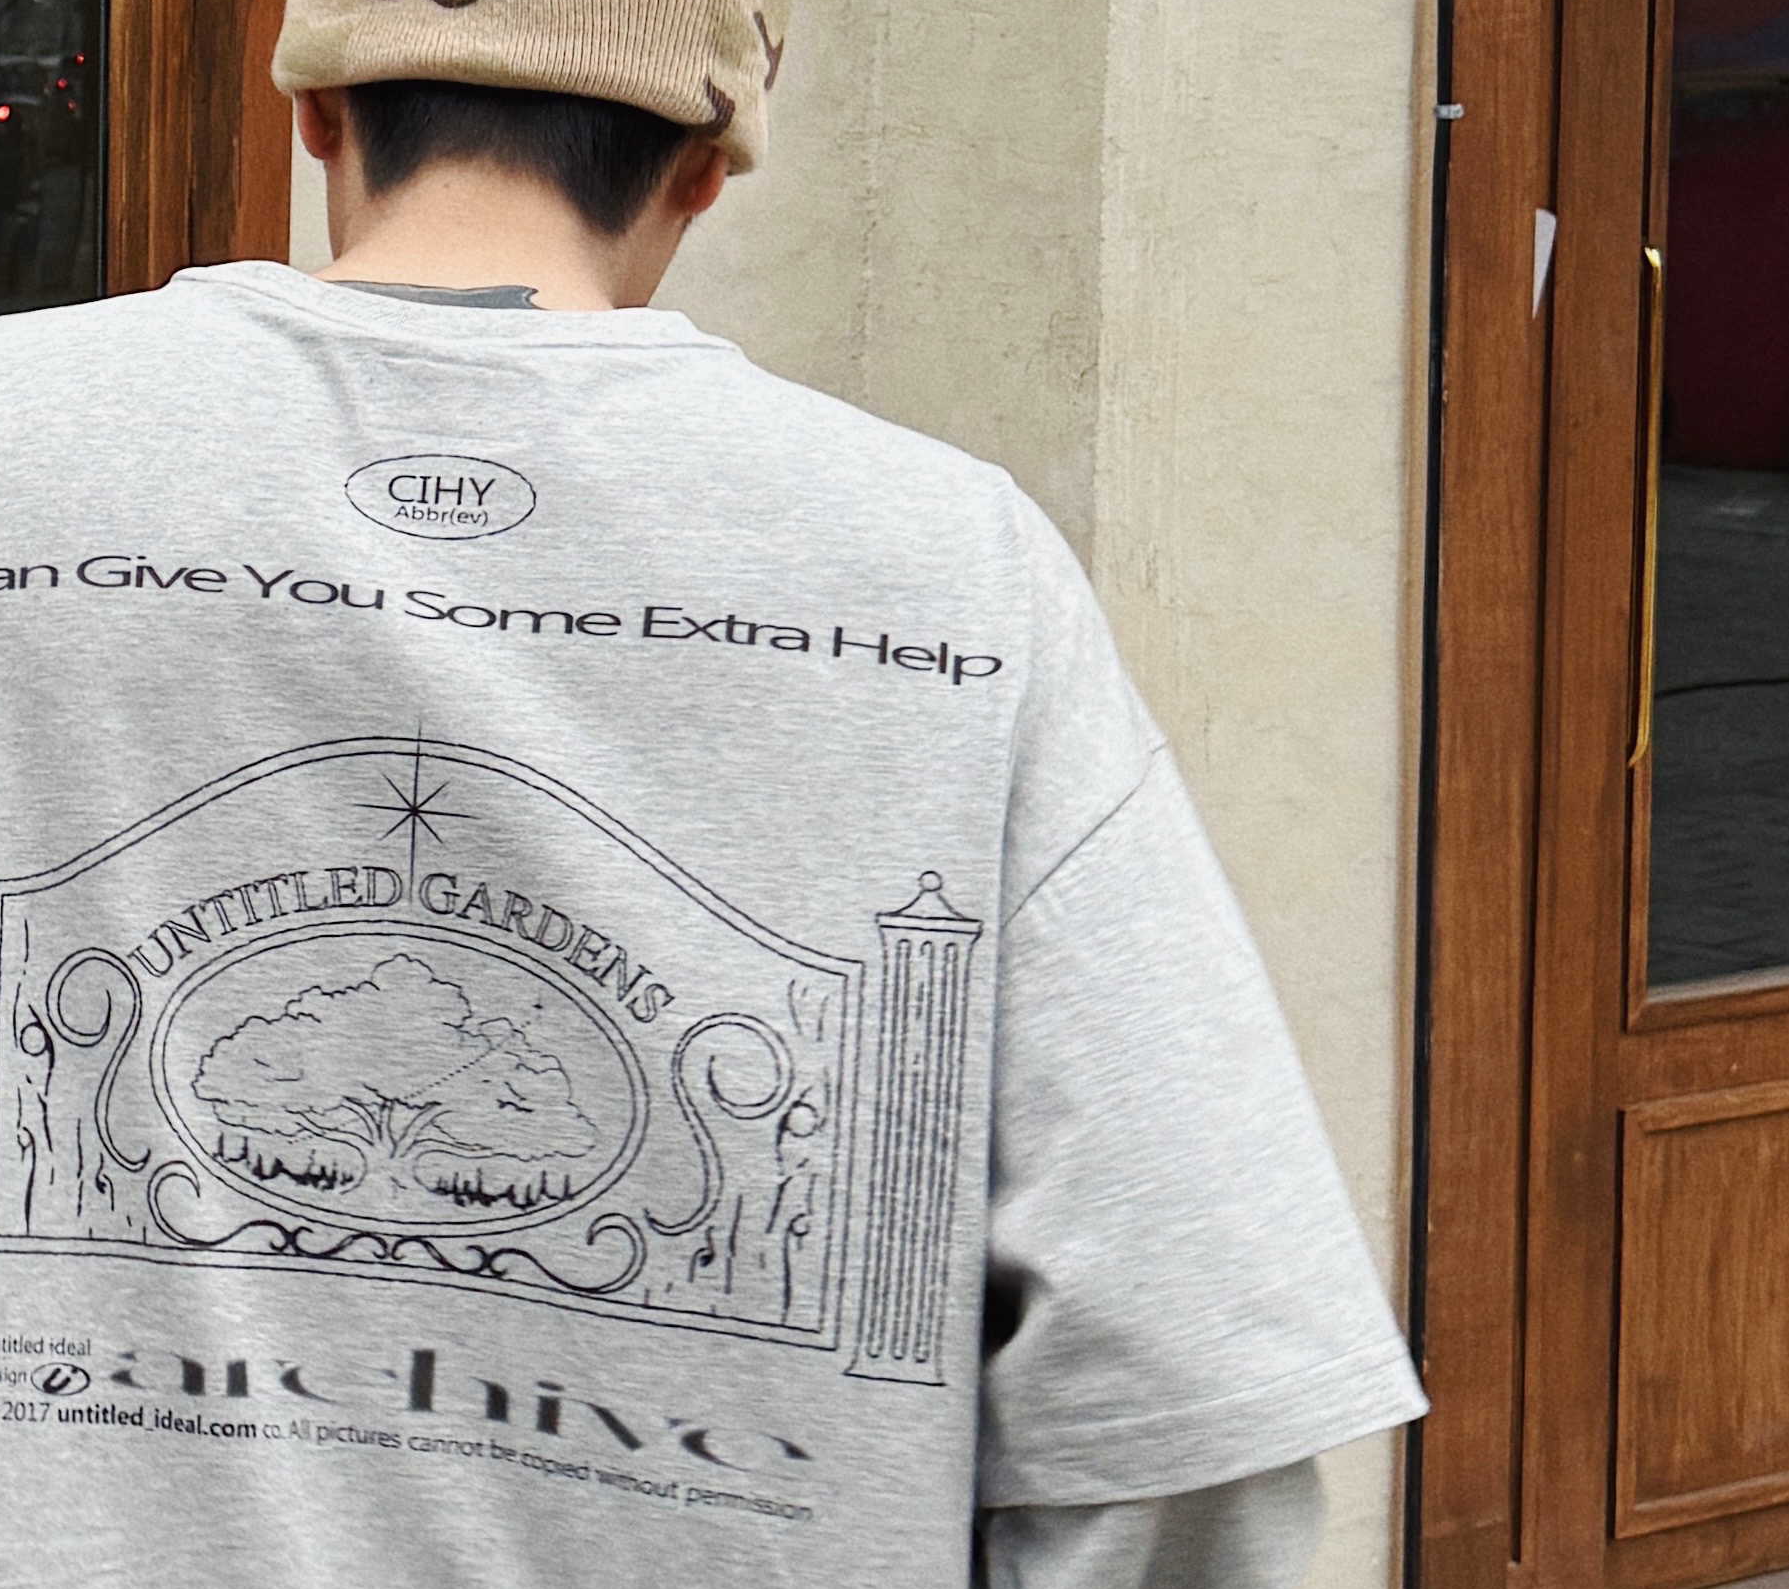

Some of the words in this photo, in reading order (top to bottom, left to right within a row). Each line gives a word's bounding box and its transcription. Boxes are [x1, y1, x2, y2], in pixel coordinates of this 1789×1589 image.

[388, 475, 496, 506] CIHY
[394, 505, 489, 526] Abbr(ev)
[76, 555, 228, 593] Give
[242, 564, 384, 610] You
[404, 590, 622, 636] Some
[642, 606, 810, 652] Extra
[832, 626, 1003, 686] Help
[127, 866, 403, 977] UNTITLED
[419, 872, 675, 1023] GARDENS
[49, 1338, 91, 1356] ideal
[2, 1401, 50, 1422] 2017
[58, 1403, 257, 1438] untitled_ideal.com
[316, 1424, 402, 1449] pictures
[408, 1434, 483, 1457] cannot
[490, 1439, 518, 1462] be
